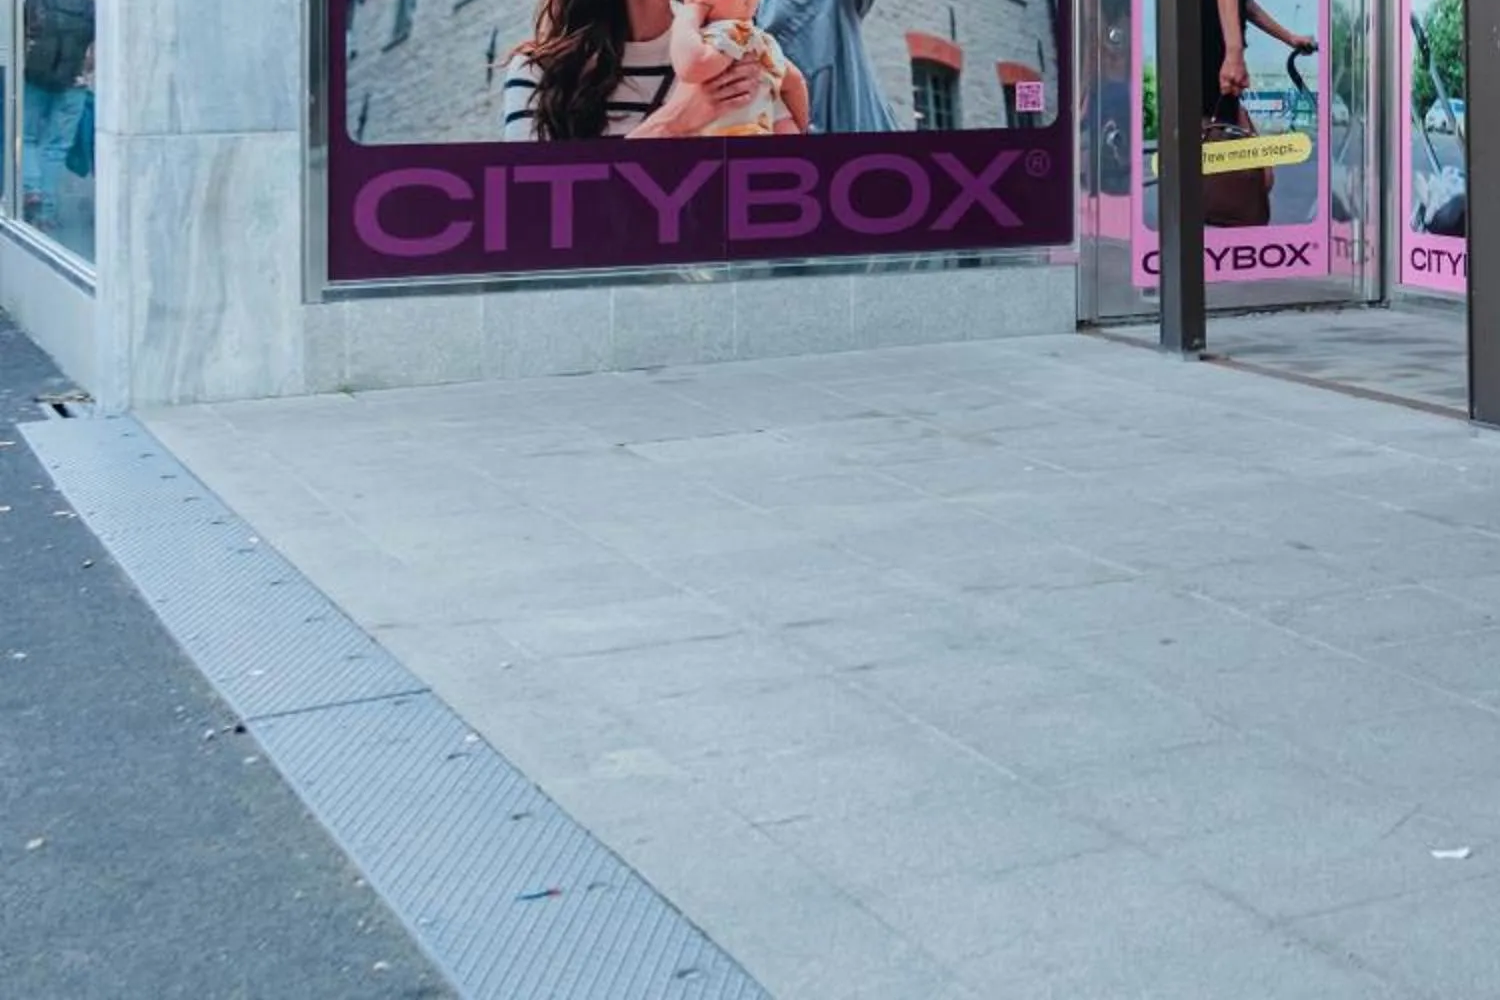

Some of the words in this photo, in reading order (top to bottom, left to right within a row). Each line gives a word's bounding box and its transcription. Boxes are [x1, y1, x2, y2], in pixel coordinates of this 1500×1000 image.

[1228, 147, 1260, 160] more
[1142, 242, 1312, 275] CYBOX
[1411, 247, 1467, 277] CITY
